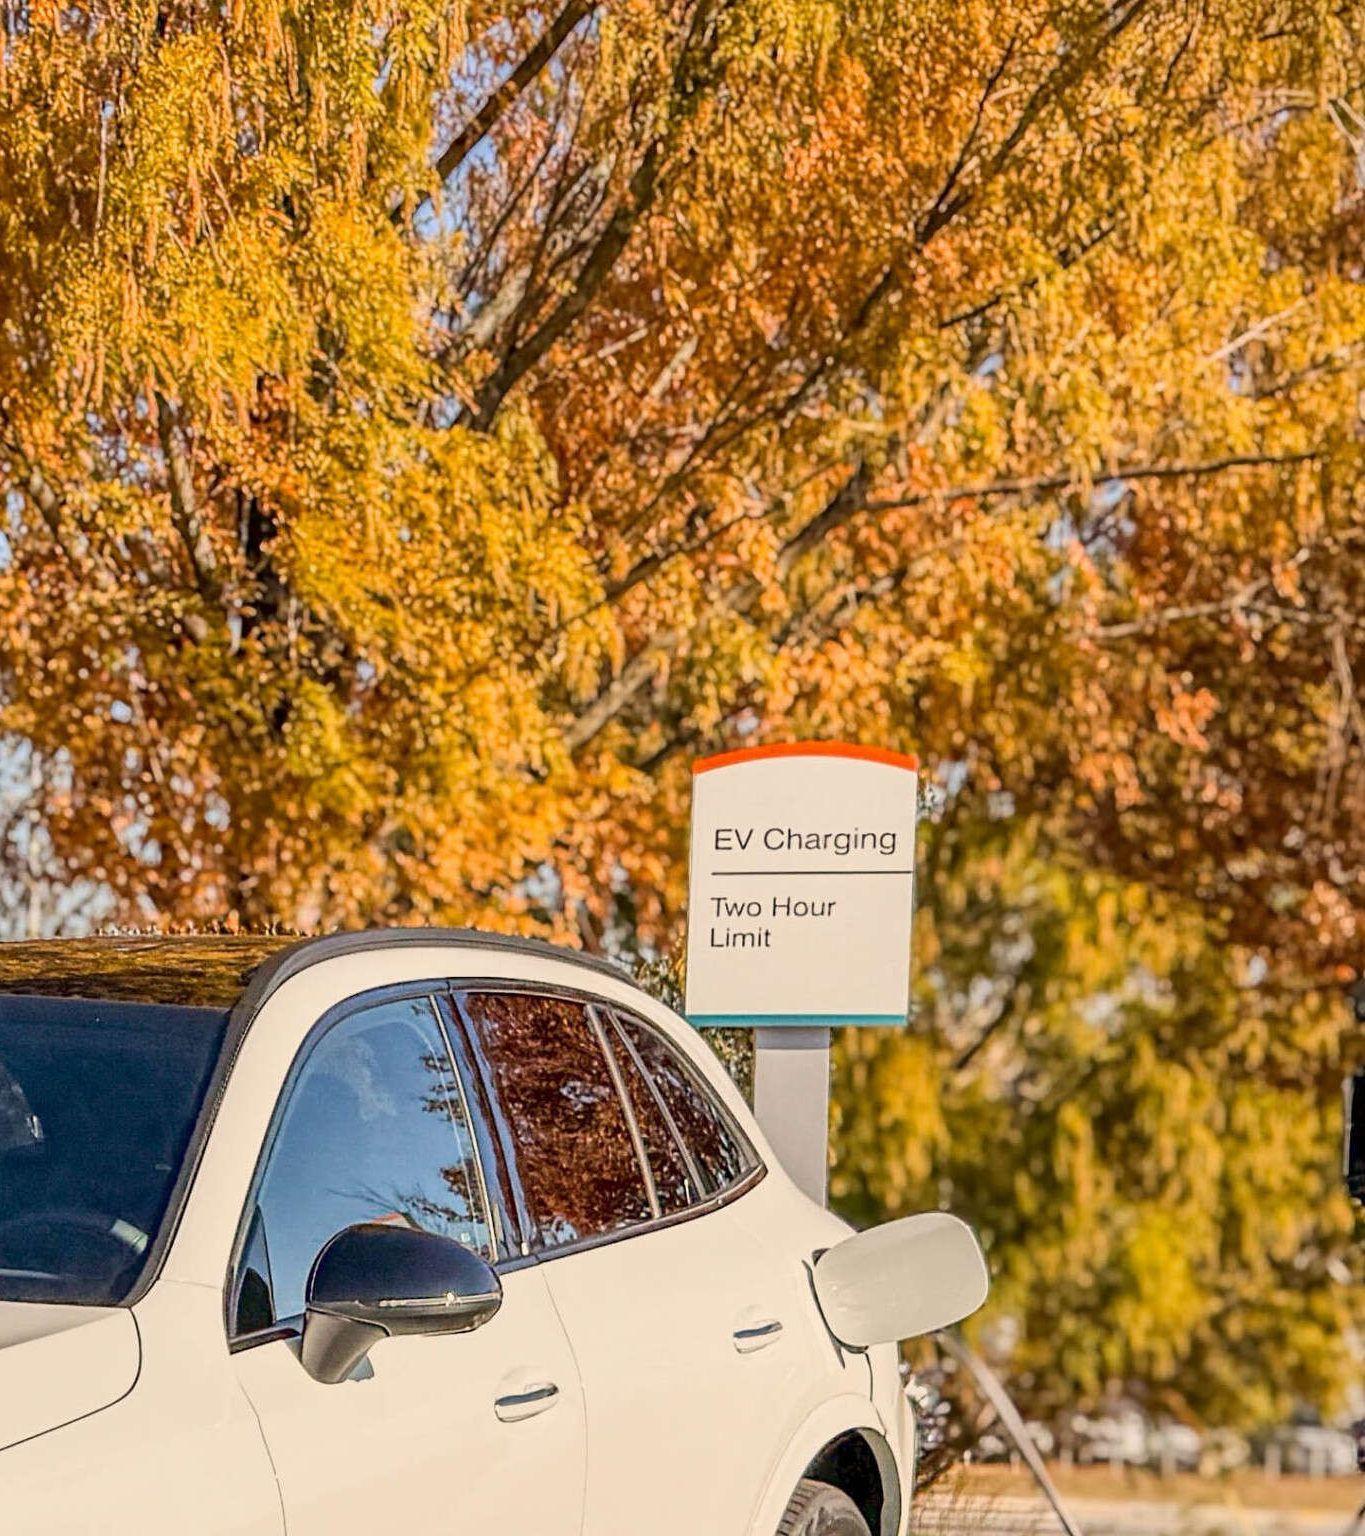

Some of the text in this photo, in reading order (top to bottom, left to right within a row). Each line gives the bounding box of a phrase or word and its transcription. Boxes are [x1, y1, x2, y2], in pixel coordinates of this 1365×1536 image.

[714, 827, 897, 856] EV Charging
[710, 896, 837, 918] Two Hour
[710, 926, 772, 949] Limit
